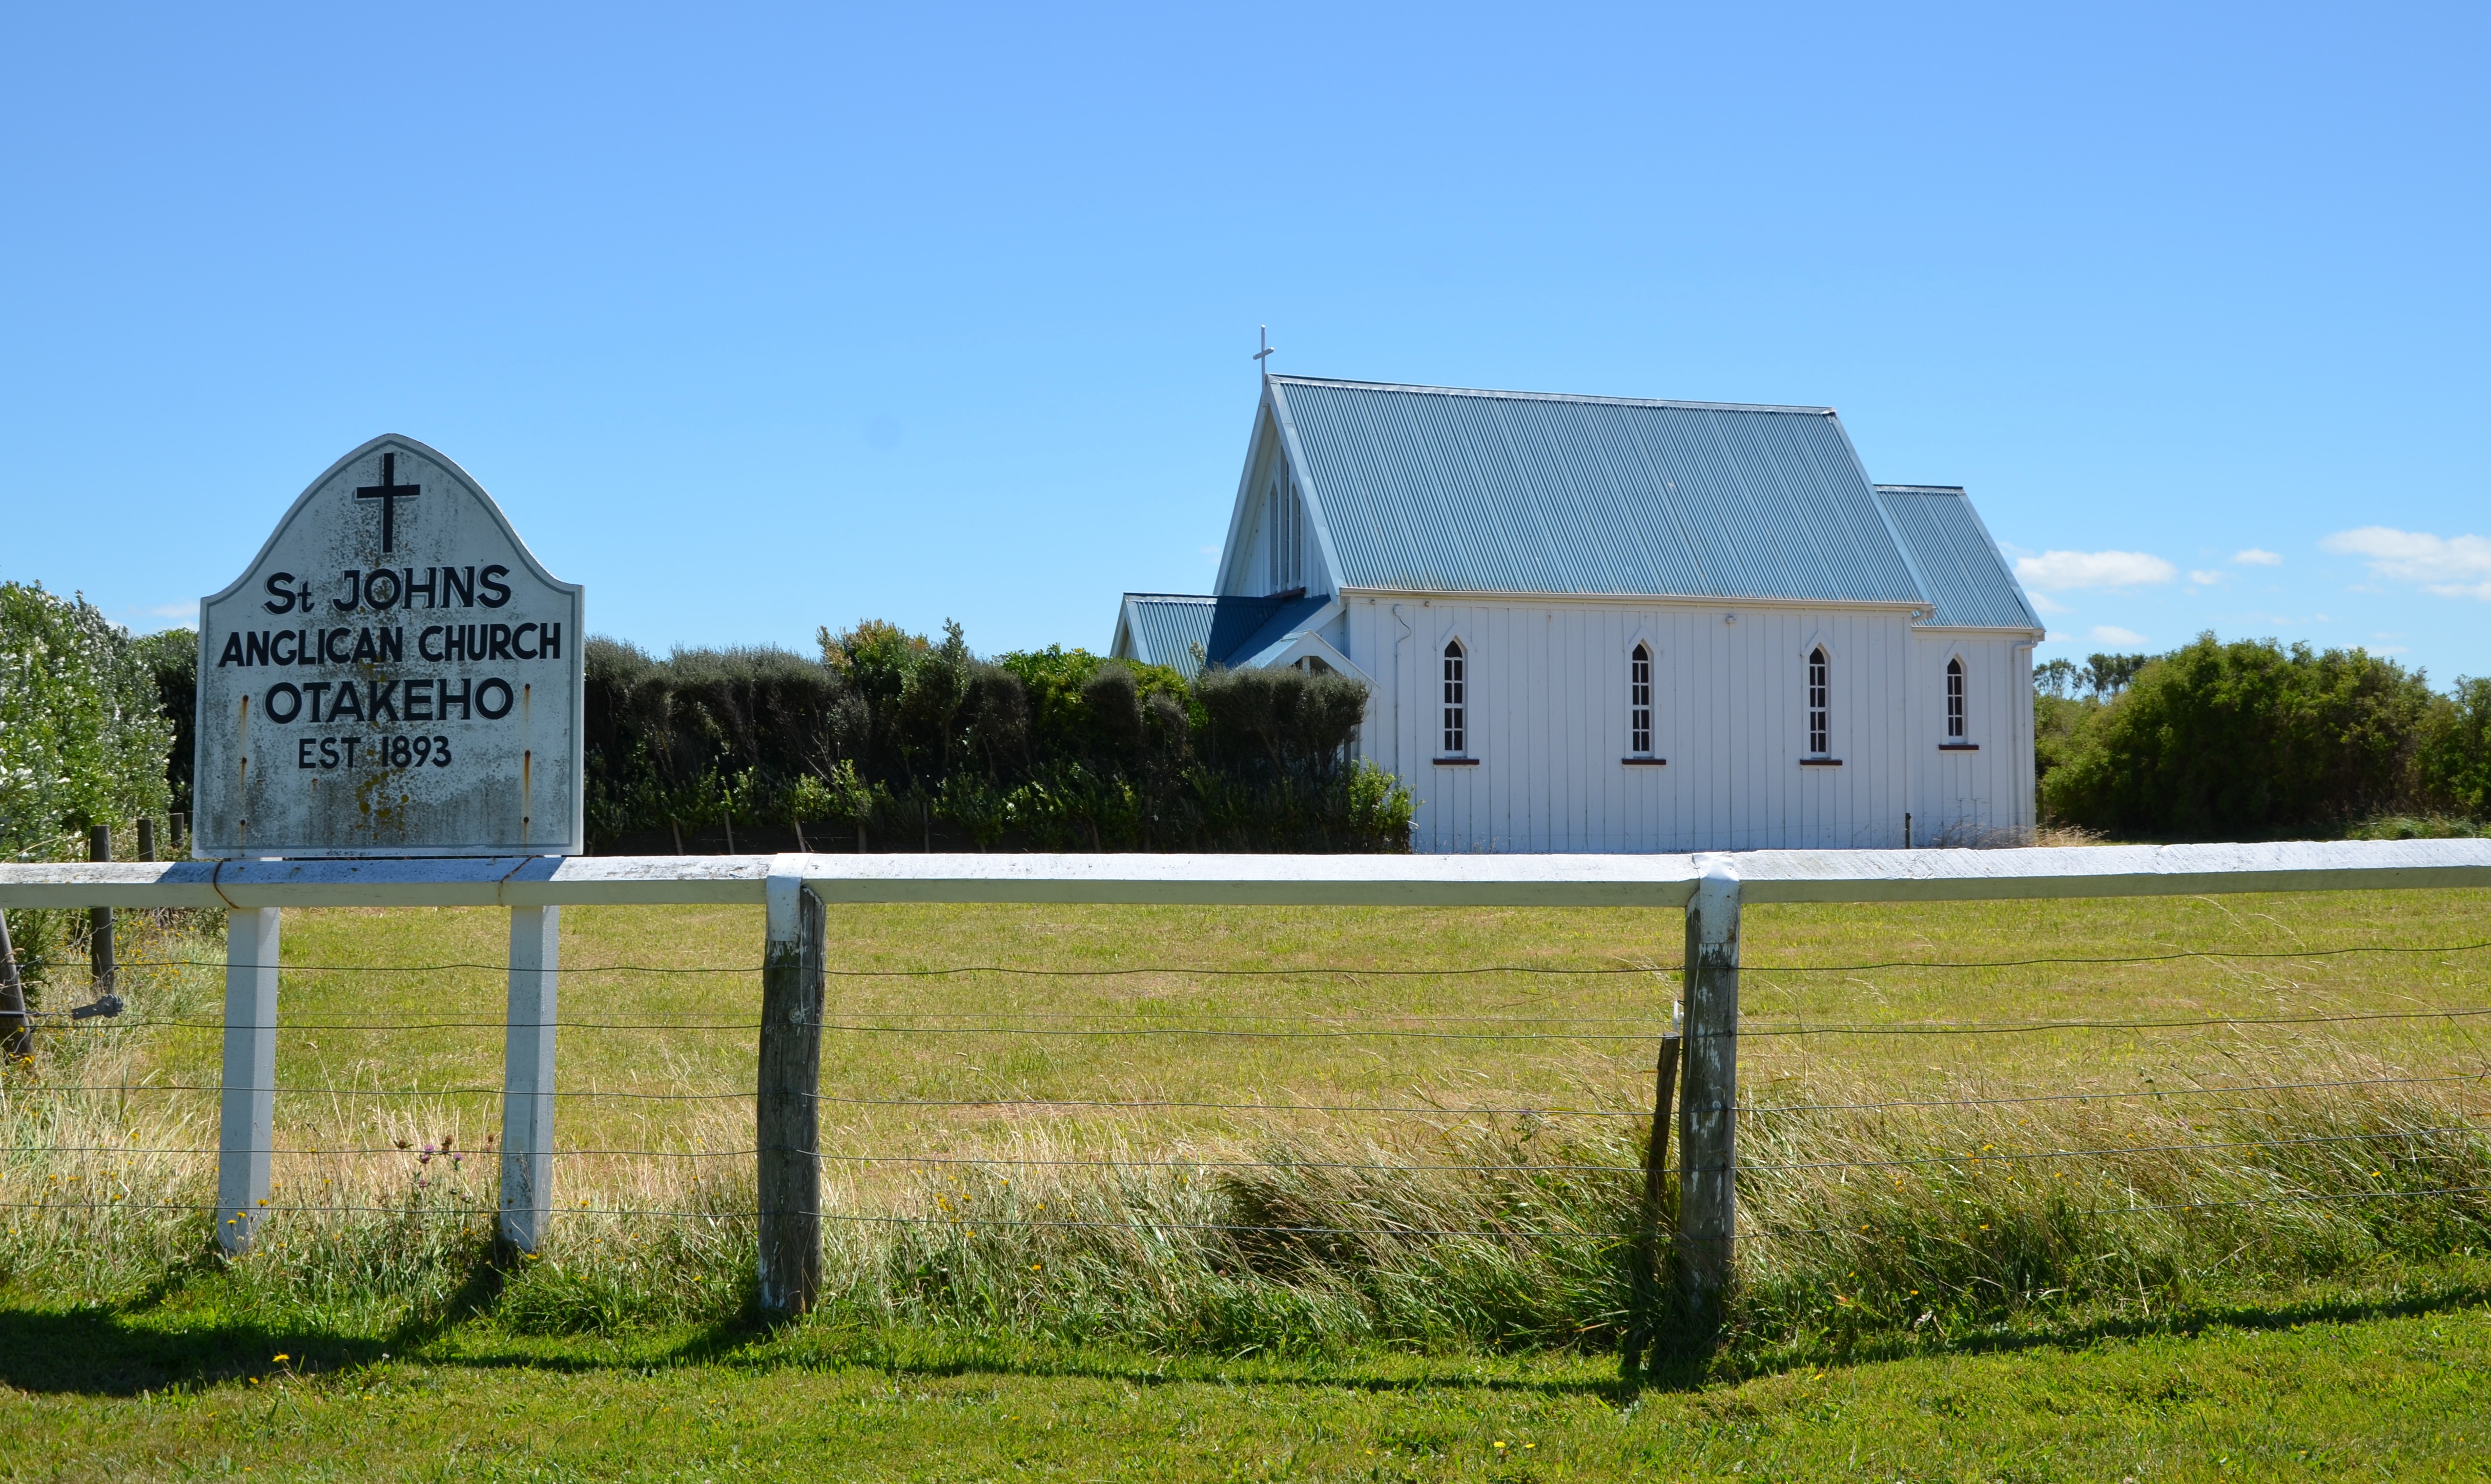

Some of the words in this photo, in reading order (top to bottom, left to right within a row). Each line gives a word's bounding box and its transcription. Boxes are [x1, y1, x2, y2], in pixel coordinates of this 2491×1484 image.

[263, 572, 315, 615] St
[333, 565, 511, 611] JOHNS
[218, 626, 403, 667] ANGLICAN
[418, 623, 561, 662] CHURCH
[264, 677, 514, 724] OTAKEHO
[299, 736, 361, 769] EST
[382, 735, 451, 768] 1893
